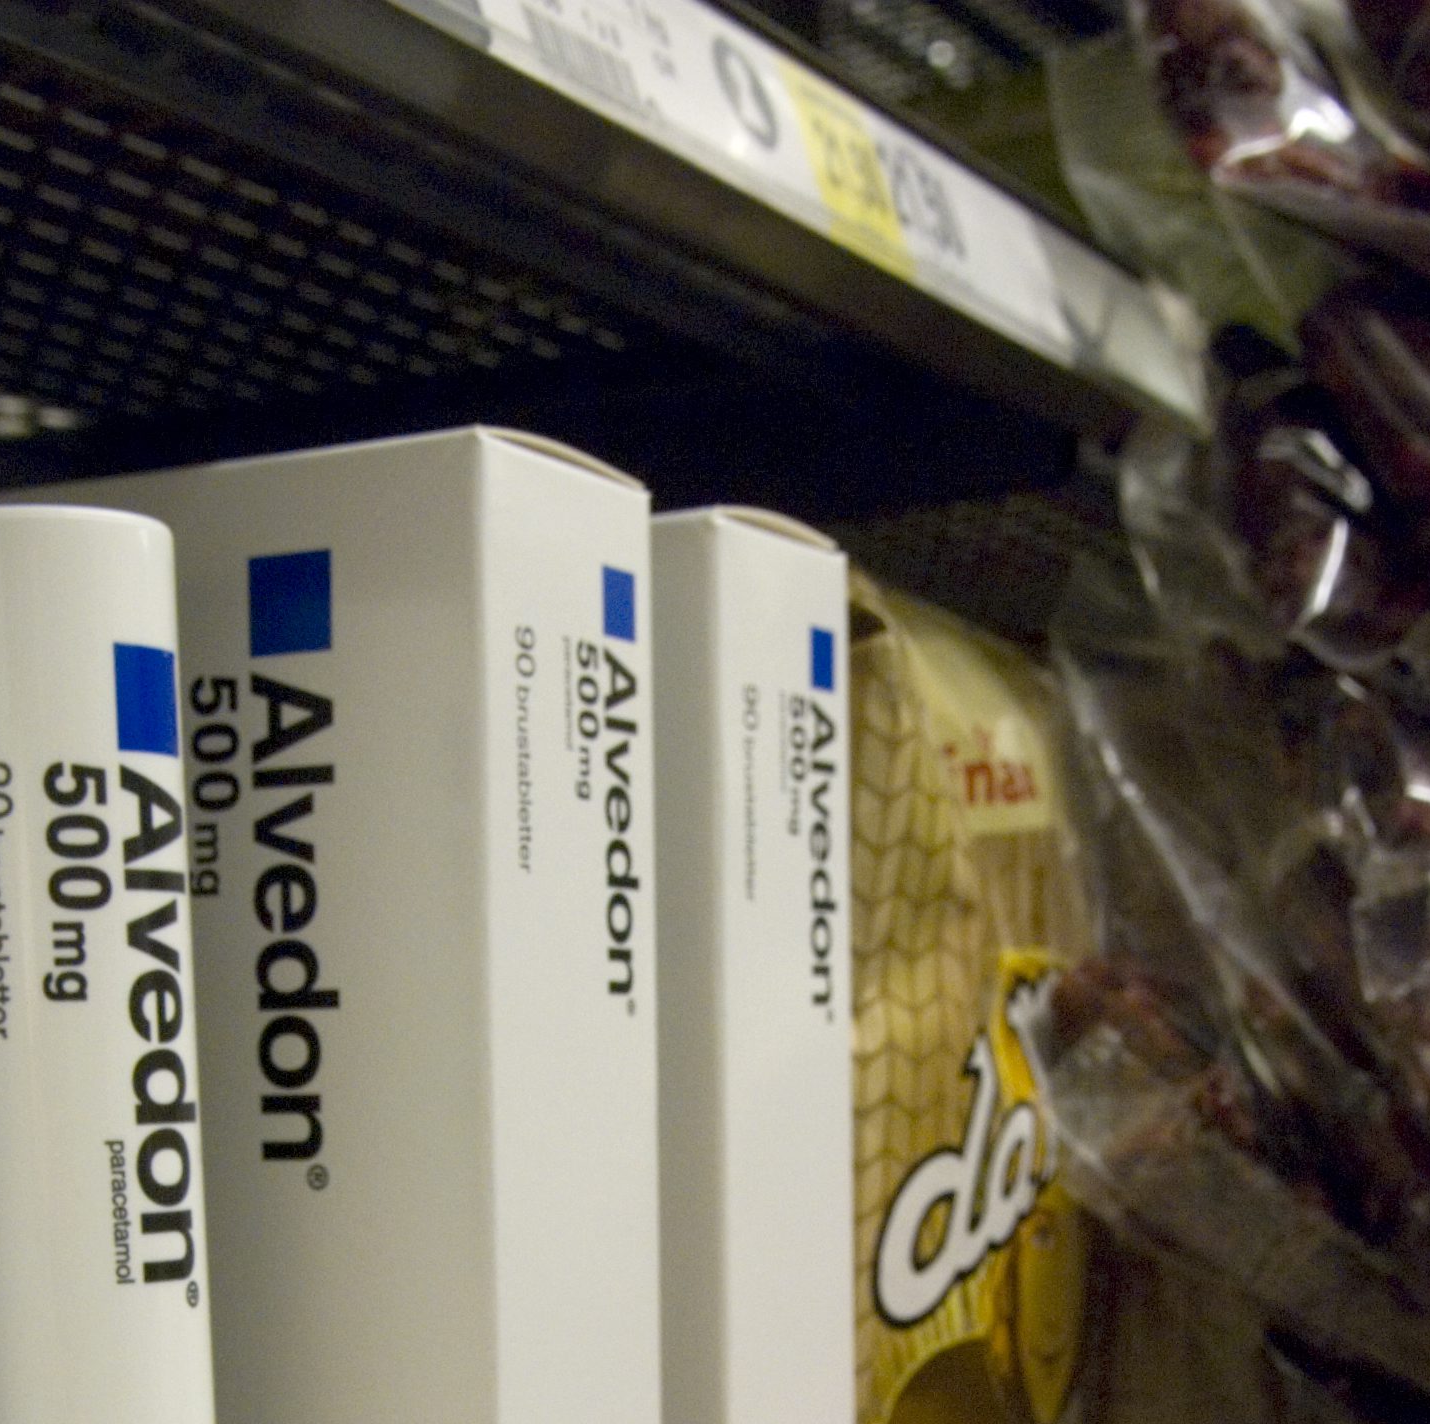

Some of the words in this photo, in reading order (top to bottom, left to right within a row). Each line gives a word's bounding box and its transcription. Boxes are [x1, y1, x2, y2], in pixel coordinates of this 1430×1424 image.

[516, 626, 536, 678] 90
[576, 640, 600, 740] 500
[190, 676, 240, 813] 500
[516, 686, 533, 873] brustabletter
[575, 745, 591, 800] mg
[43, 762, 112, 911] 500
[190, 823, 221, 897] mg
[42, 921, 88, 1002] mg
[105, 1140, 135, 1284] paracetamol
